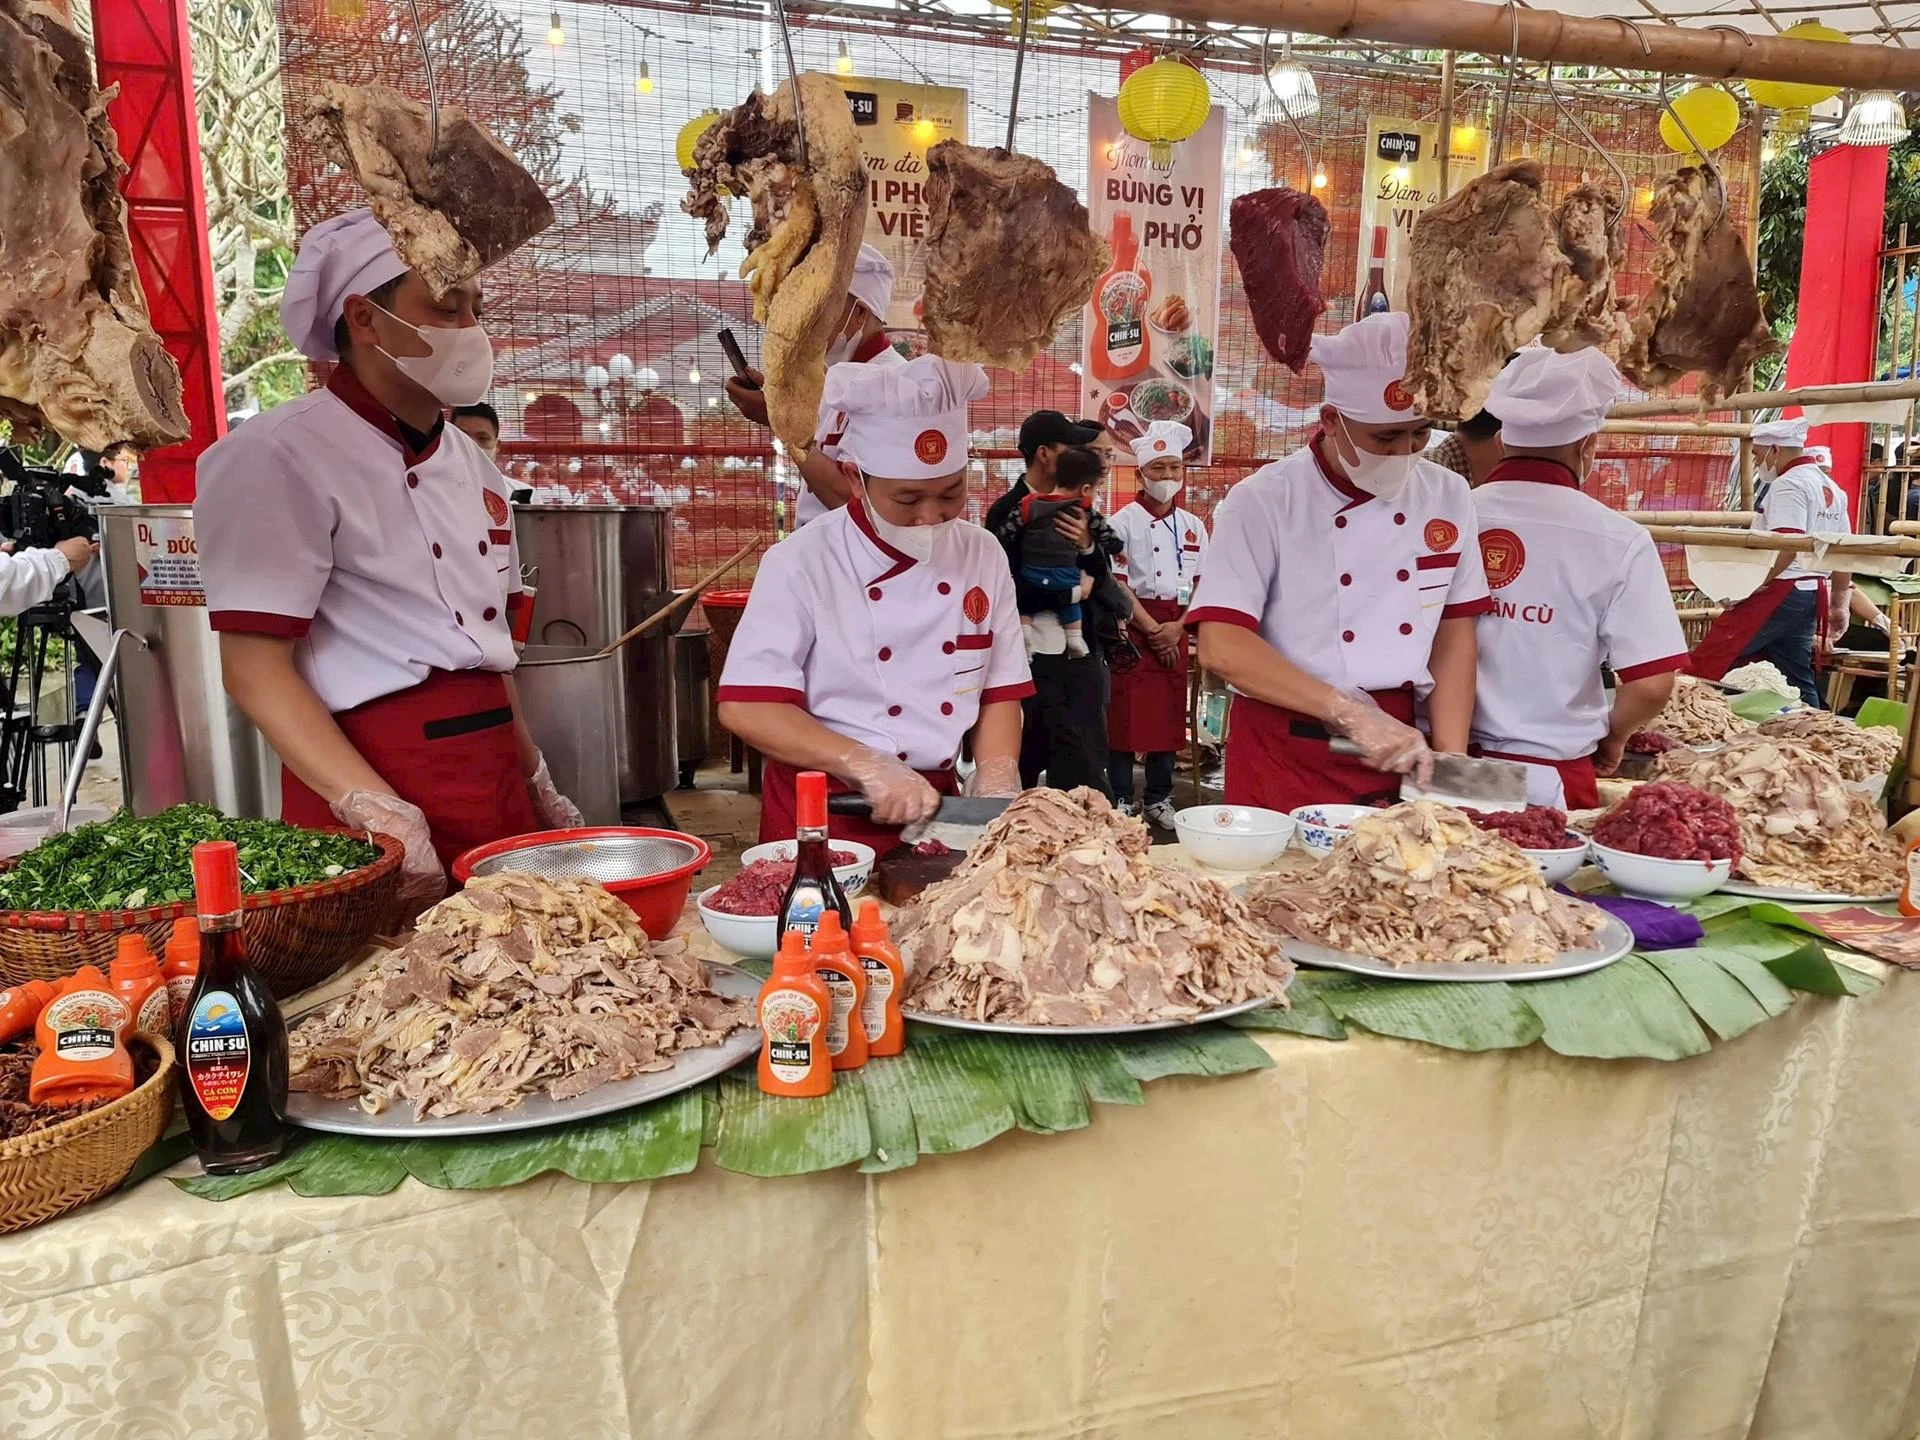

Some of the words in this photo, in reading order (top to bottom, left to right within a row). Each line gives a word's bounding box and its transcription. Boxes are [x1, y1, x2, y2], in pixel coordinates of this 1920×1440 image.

[871, 180, 879, 208] Ị
[1106, 173, 1174, 206] BÙNG
[1180, 185, 1204, 214] VỊ
[1392, 208, 1414, 234] VỊ
[1143, 214, 1203, 251] PHỞ
[1109, 328, 1140, 342] CHIN-SU
[170, 596, 193, 605] 0975
[1487, 597, 1517, 619] ÂN
[1522, 603, 1554, 624] CÙ
[59, 1034, 112, 1046] CHIN-SU
[191, 1037, 246, 1053] CHIN-SU
[771, 1047, 808, 1060] CHIN-SU
